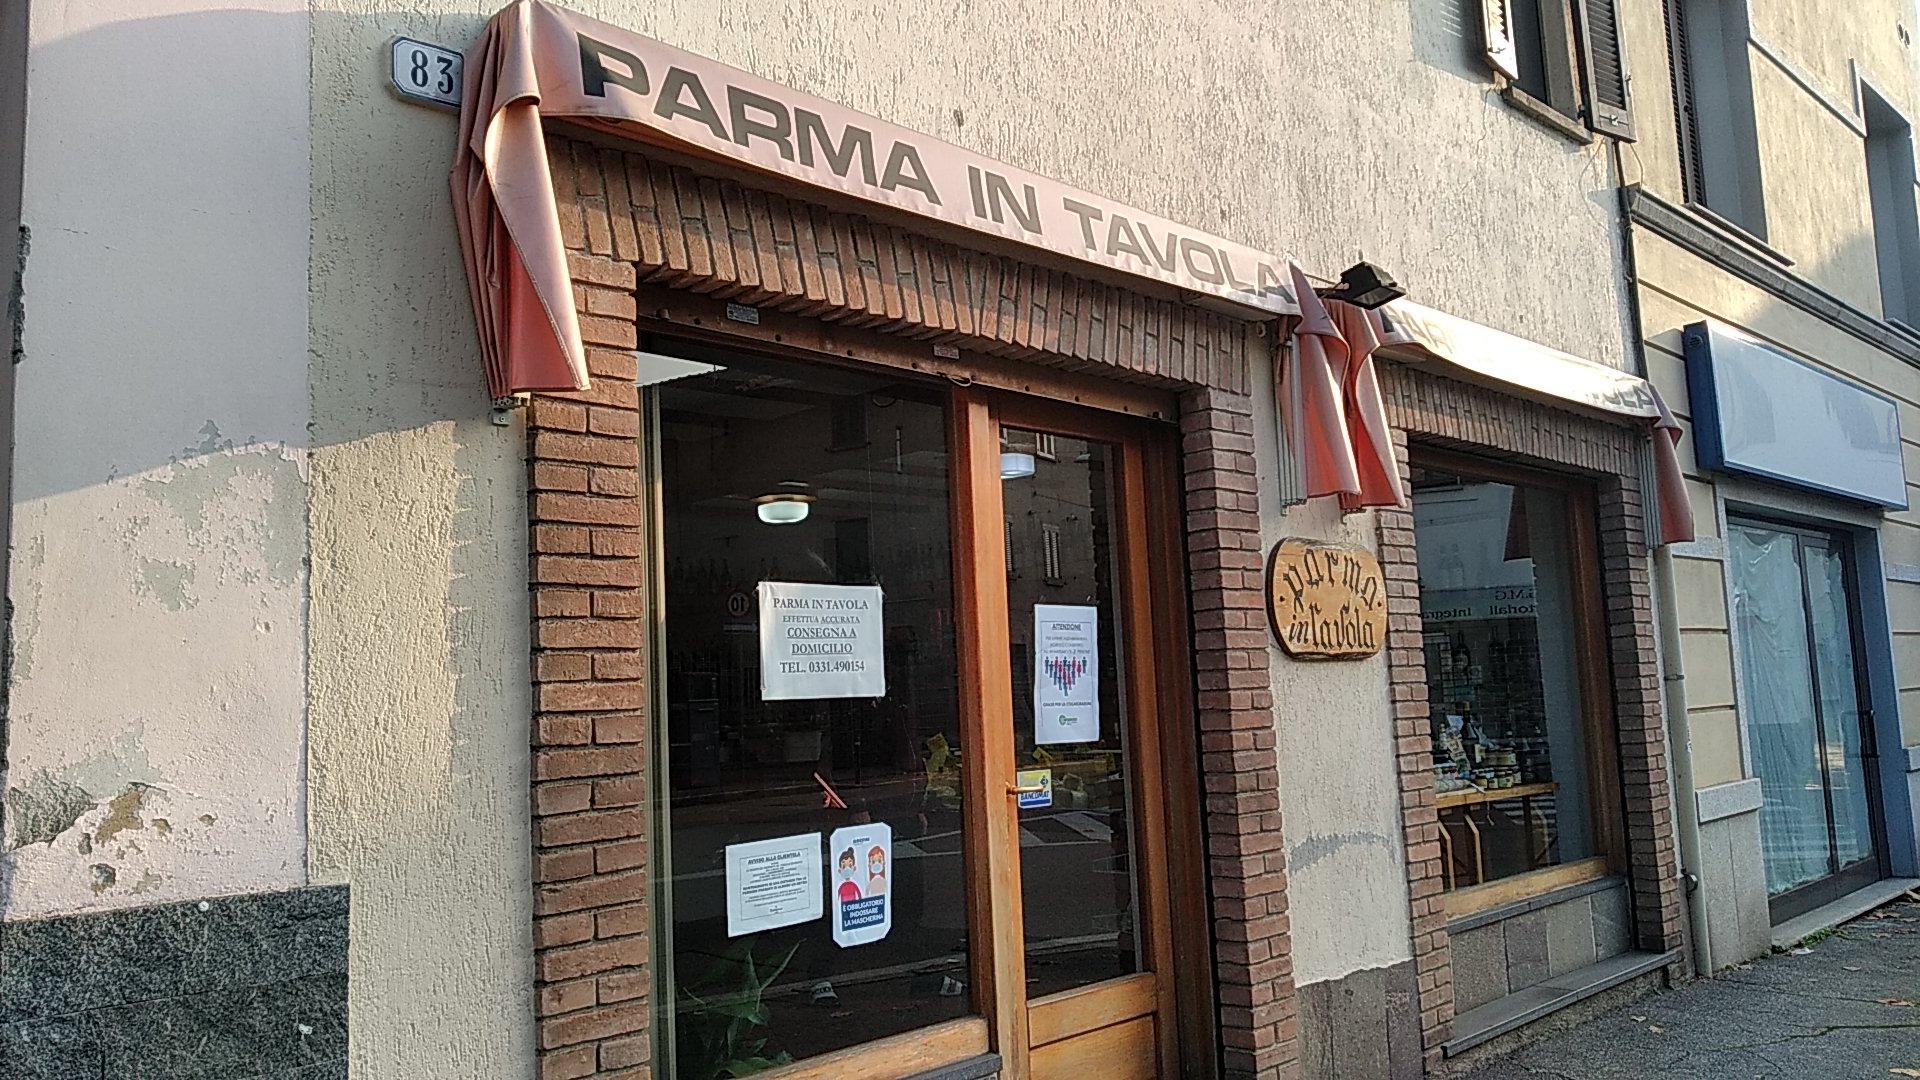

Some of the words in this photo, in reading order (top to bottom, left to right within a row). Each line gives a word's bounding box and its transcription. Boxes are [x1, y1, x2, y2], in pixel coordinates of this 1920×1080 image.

[410, 48, 455, 95] 83
[577, 33, 942, 206] PARMA
[967, 165, 1042, 235] IN
[1063, 198, 1296, 305] TAVOLA
[773, 598, 809, 609] PARMA
[812, 599, 823, 609] IN
[826, 600, 869, 610] TAVOLA
[783, 615, 819, 623] EFFETTUA
[821, 616, 861, 624] ACCURATA
[1309, 601, 1376, 650] tavola
[787, 627, 847, 638] CONSEGNA
[849, 628, 857, 637] A
[1052, 623, 1082, 631] ATTENZIONE
[791, 643, 853, 655] DOMICILIO
[780, 662, 807, 673] TEL.
[809, 661, 865, 673] 0331.490154
[1020, 790, 1050, 801] BANCOMAT
[748, 857, 765, 865] AVVISO
[777, 852, 801, 860] CLIENTELA
[847, 899, 884, 911] OBBLIGATORIO
[850, 907, 879, 918] INDOSSARE
[852, 914, 884, 925] MASCHERINA
